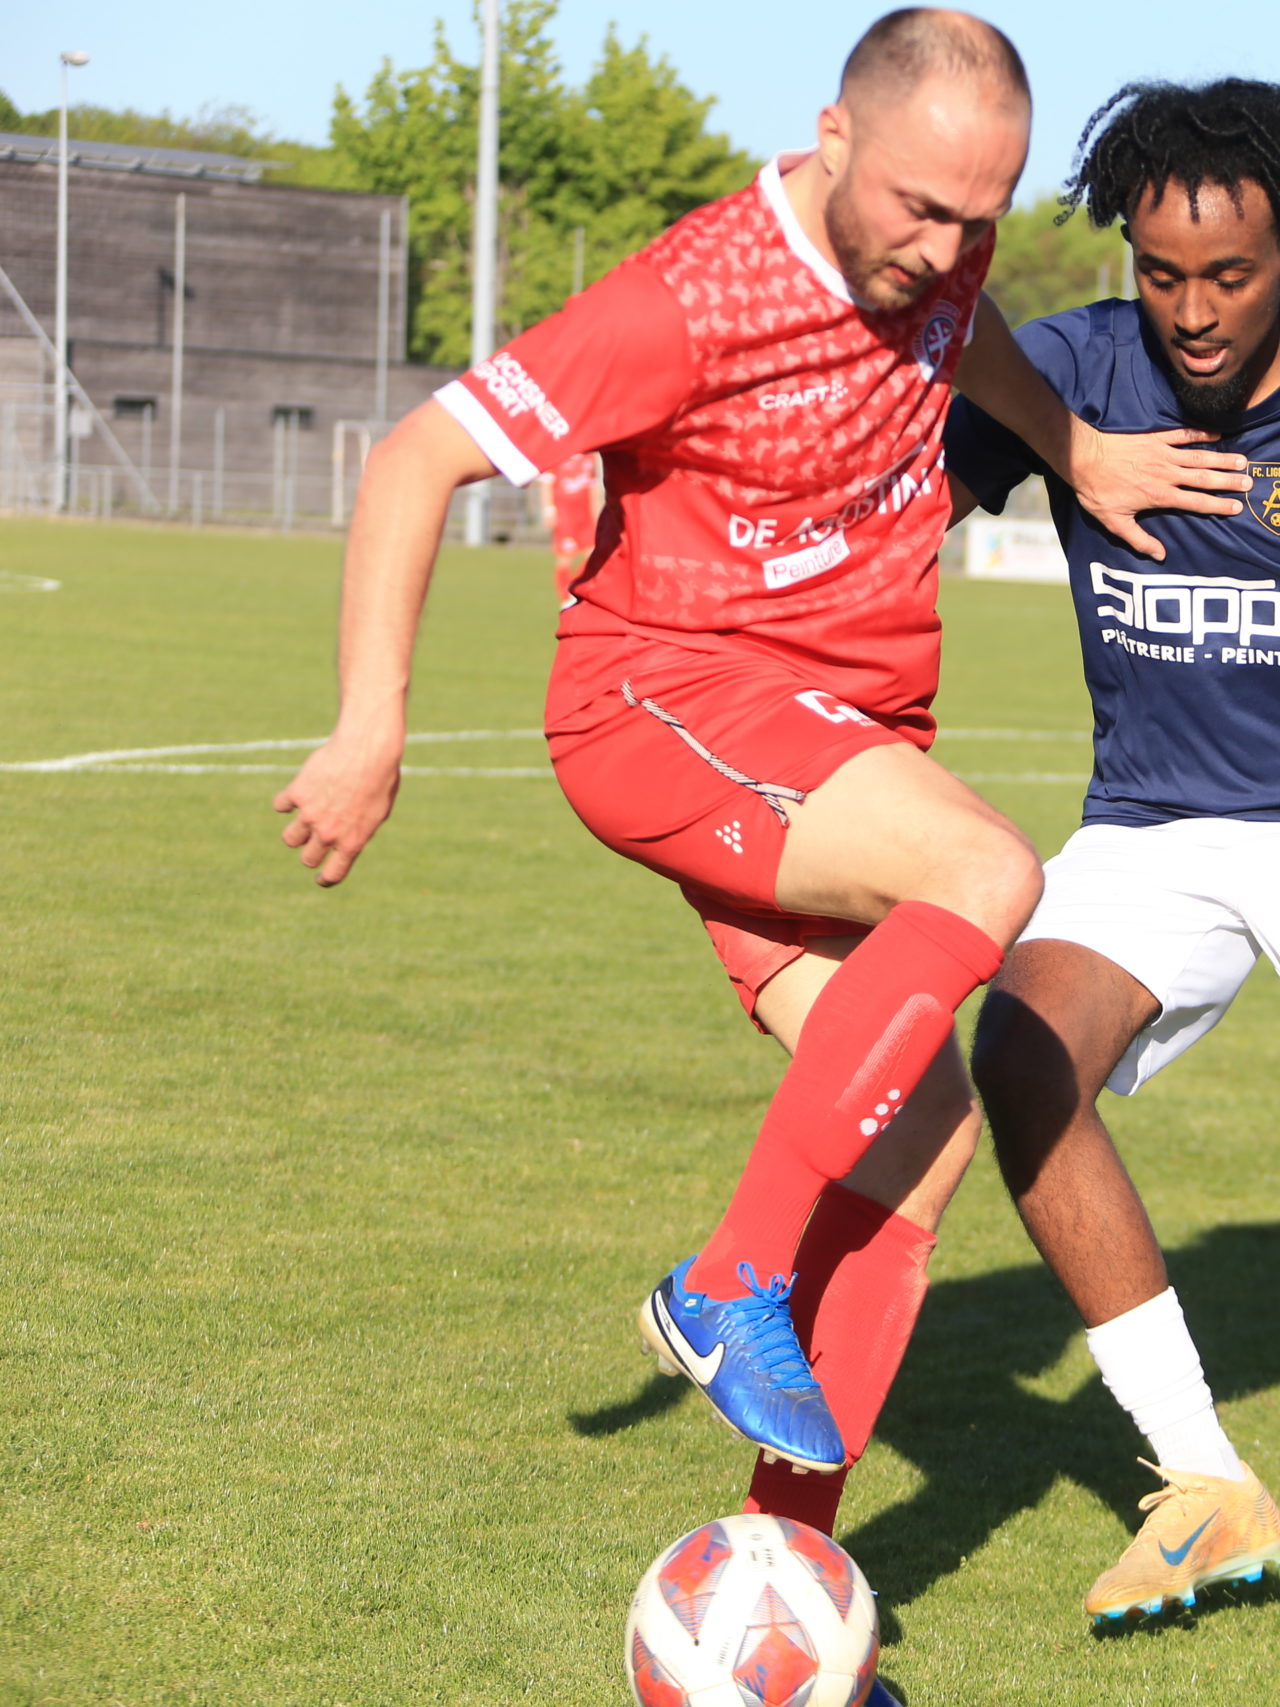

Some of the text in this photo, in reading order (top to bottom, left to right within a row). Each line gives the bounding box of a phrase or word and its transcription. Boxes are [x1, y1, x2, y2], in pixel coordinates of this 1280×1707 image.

[473, 361, 529, 418] SPORT
[758, 385, 830, 410] CRAFT
[729, 513, 778, 549] DE
[772, 538, 844, 580] Peinture
